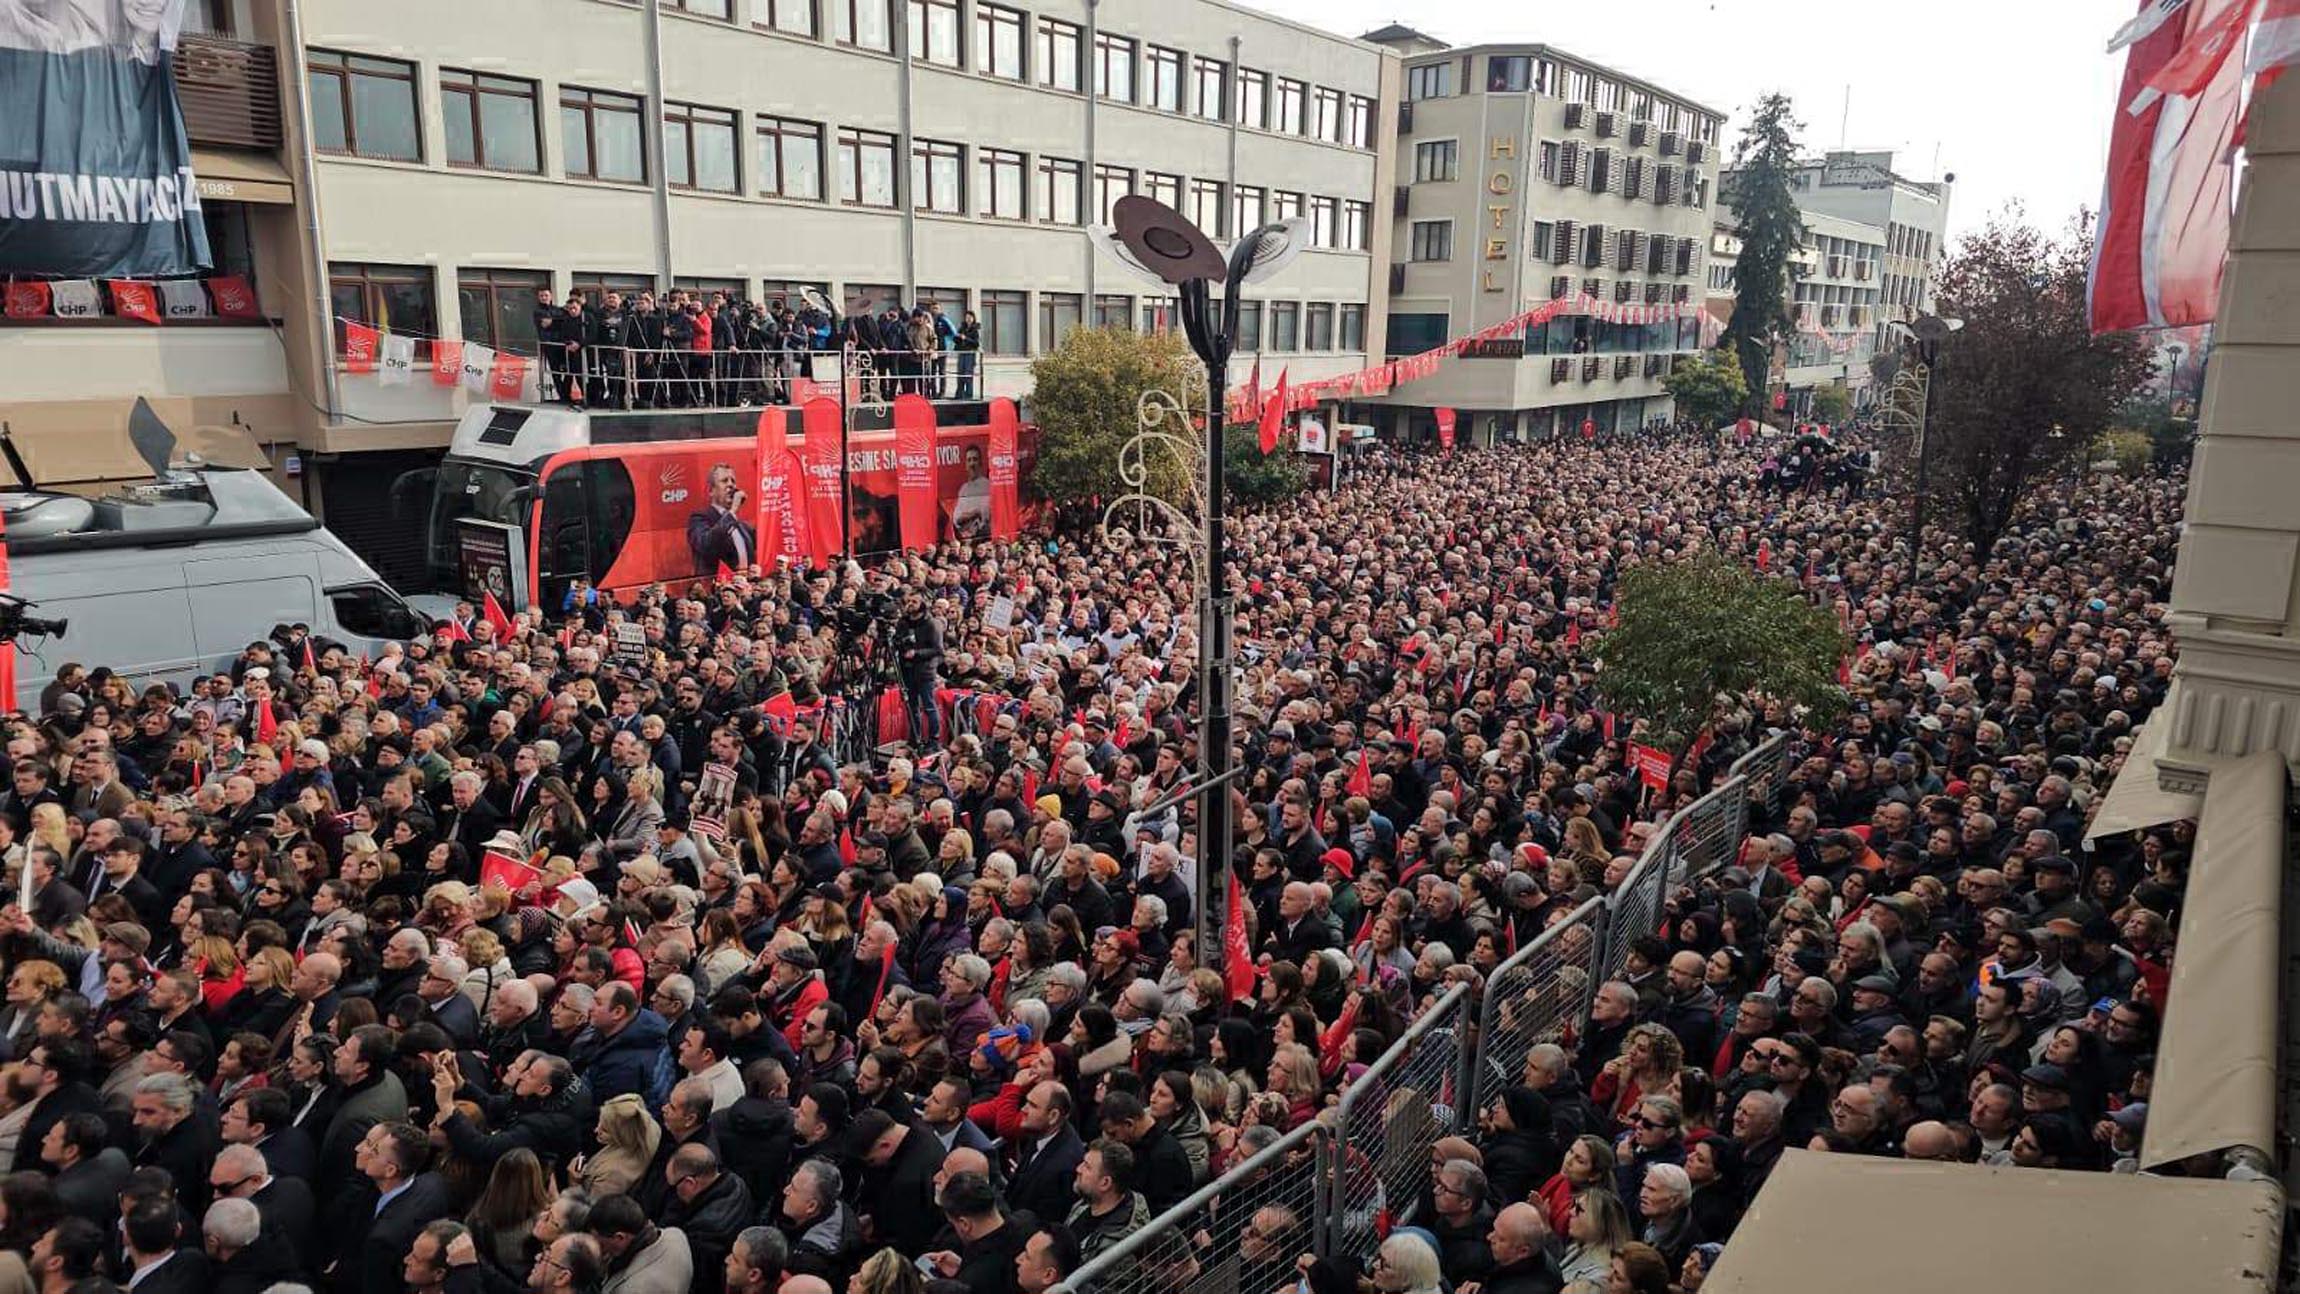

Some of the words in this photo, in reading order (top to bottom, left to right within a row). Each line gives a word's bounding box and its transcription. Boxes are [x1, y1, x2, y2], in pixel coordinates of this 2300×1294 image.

[201, 183, 236, 196] 1985
[1484, 134, 1515, 293] HOTEL
[60, 304, 87, 315] CHP
[123, 302, 146, 312] CHP
[171, 305, 196, 315] CHP
[386, 358, 408, 369] CHP
[464, 364, 483, 376] CHP
[662, 489, 688, 502] CHP
